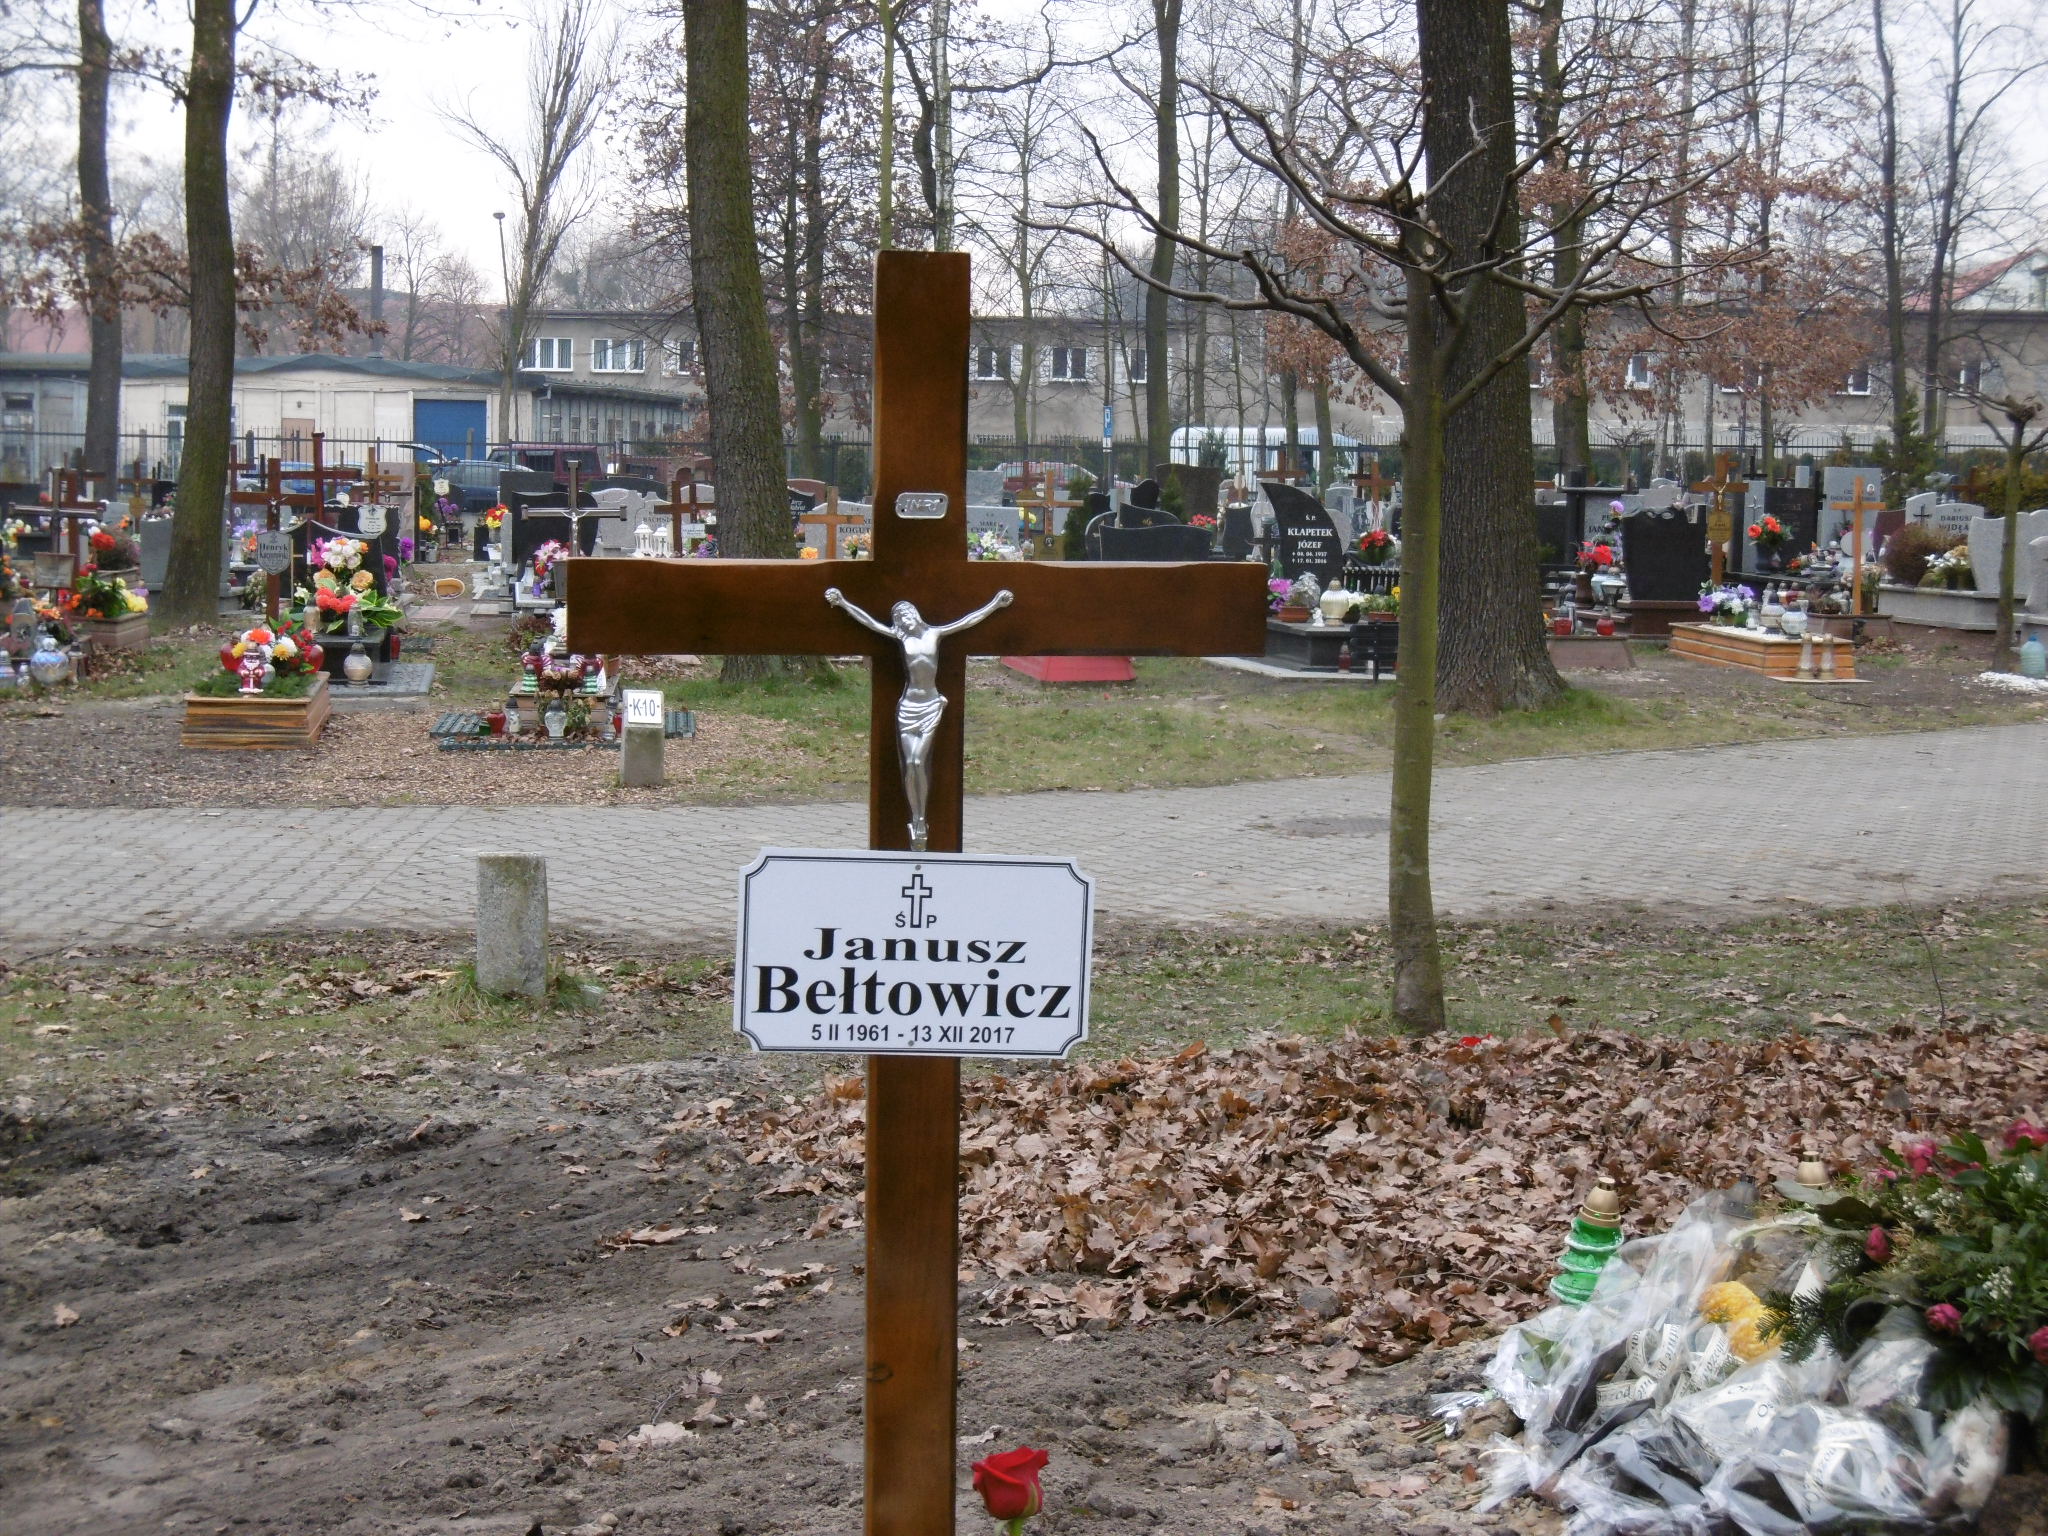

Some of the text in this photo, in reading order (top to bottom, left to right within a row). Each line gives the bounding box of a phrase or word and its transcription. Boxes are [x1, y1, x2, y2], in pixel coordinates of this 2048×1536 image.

[1287, 527, 1333, 537] KLAPETEK
[1297, 540, 1323, 549] JÓZEF
[633, 698, 656, 717] K-10
[895, 911, 937, 928] Ś P
[803, 927, 1027, 964] Janusz
[752, 964, 1072, 1019] Bełtowicz
[811, 1024, 822, 1041] 5
[829, 1024, 839, 1041] II
[847, 1024, 889, 1042] 1961
[911, 1025, 932, 1043] 13
[939, 1025, 963, 1043] XII
[970, 1026, 1016, 1044] 2017
